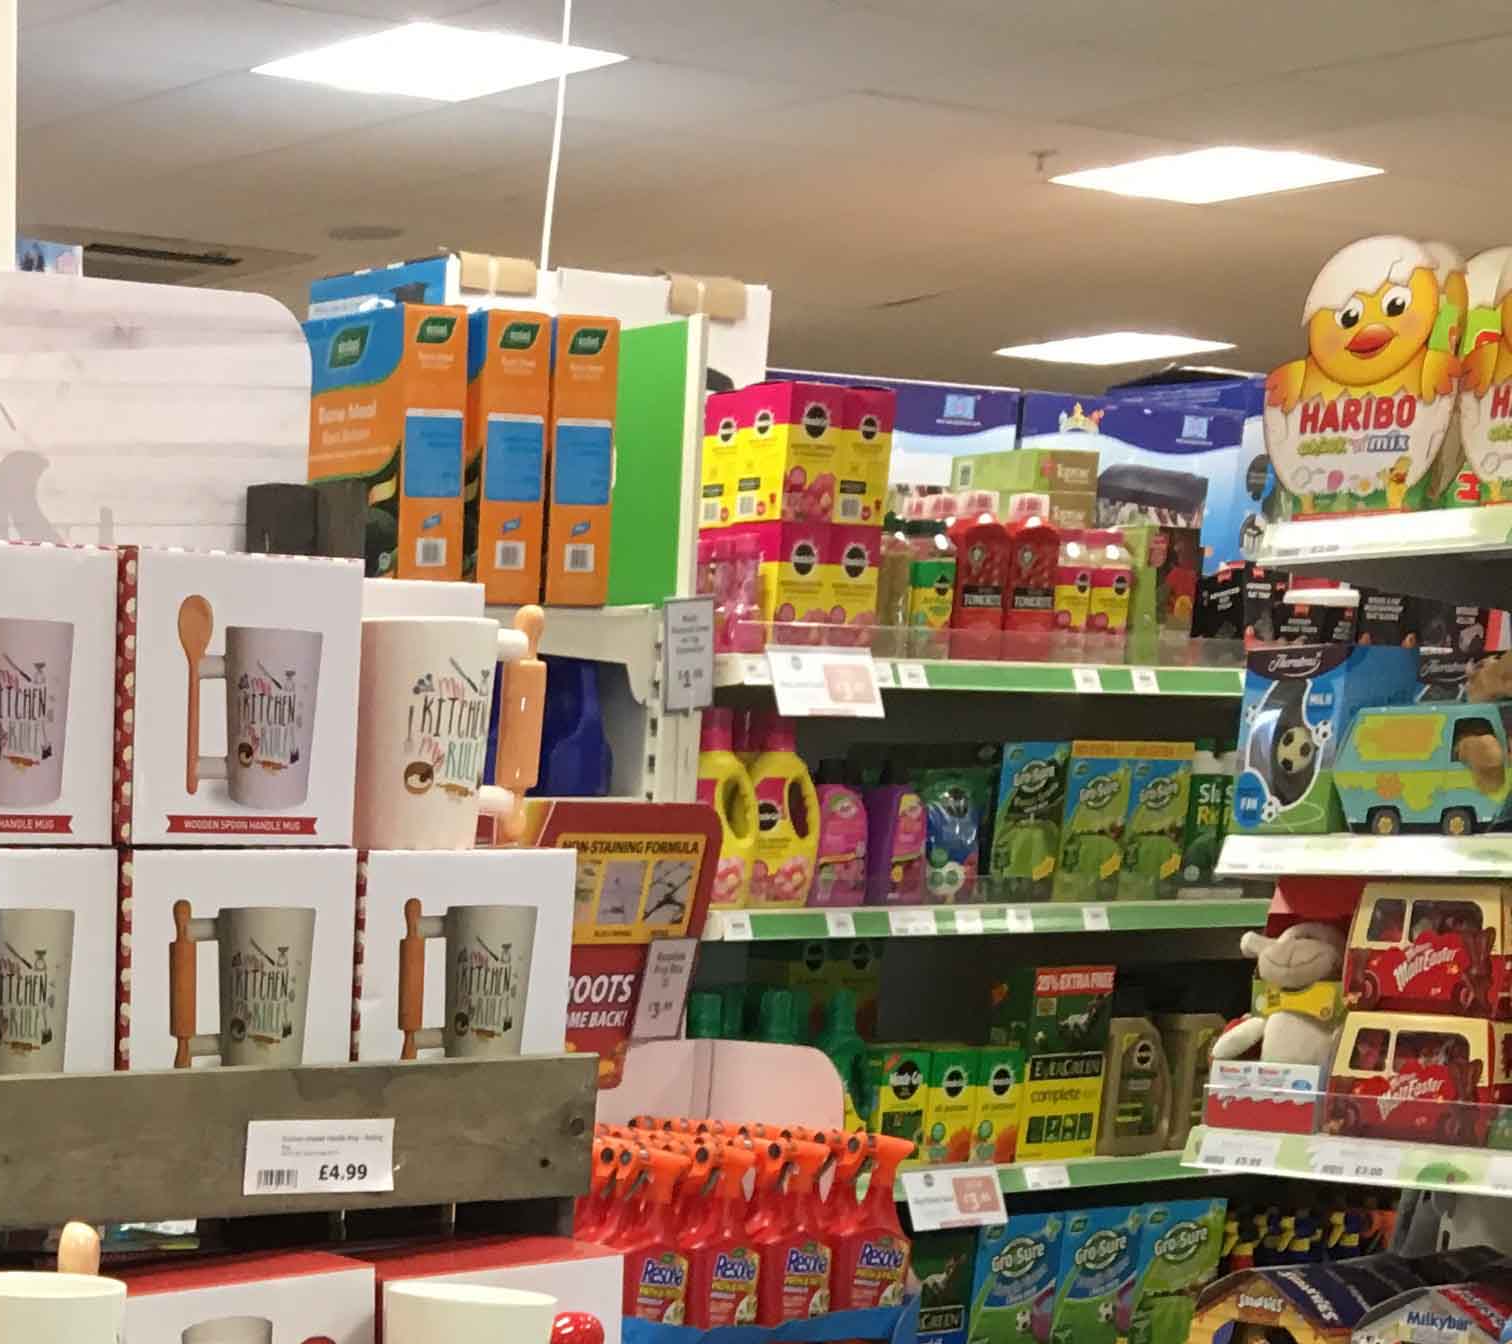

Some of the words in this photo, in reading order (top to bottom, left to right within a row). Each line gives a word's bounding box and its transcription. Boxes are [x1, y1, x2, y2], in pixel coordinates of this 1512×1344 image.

[1298, 393, 1417, 435] HARIBO
[645, 839, 700, 854] FORMULA
[236, 967, 289, 1002] KITCHEN
[461, 963, 512, 997] KITCHEN
[591, 1010, 629, 1027] BACK!
[318, 1163, 369, 1181] £4.99
[1074, 1234, 1128, 1269] Gro-Sure
[1154, 1223, 1209, 1255] Gro-Sure
[991, 1241, 1046, 1273] Gro-Sure
[1407, 1311, 1471, 1331] Milkybar
